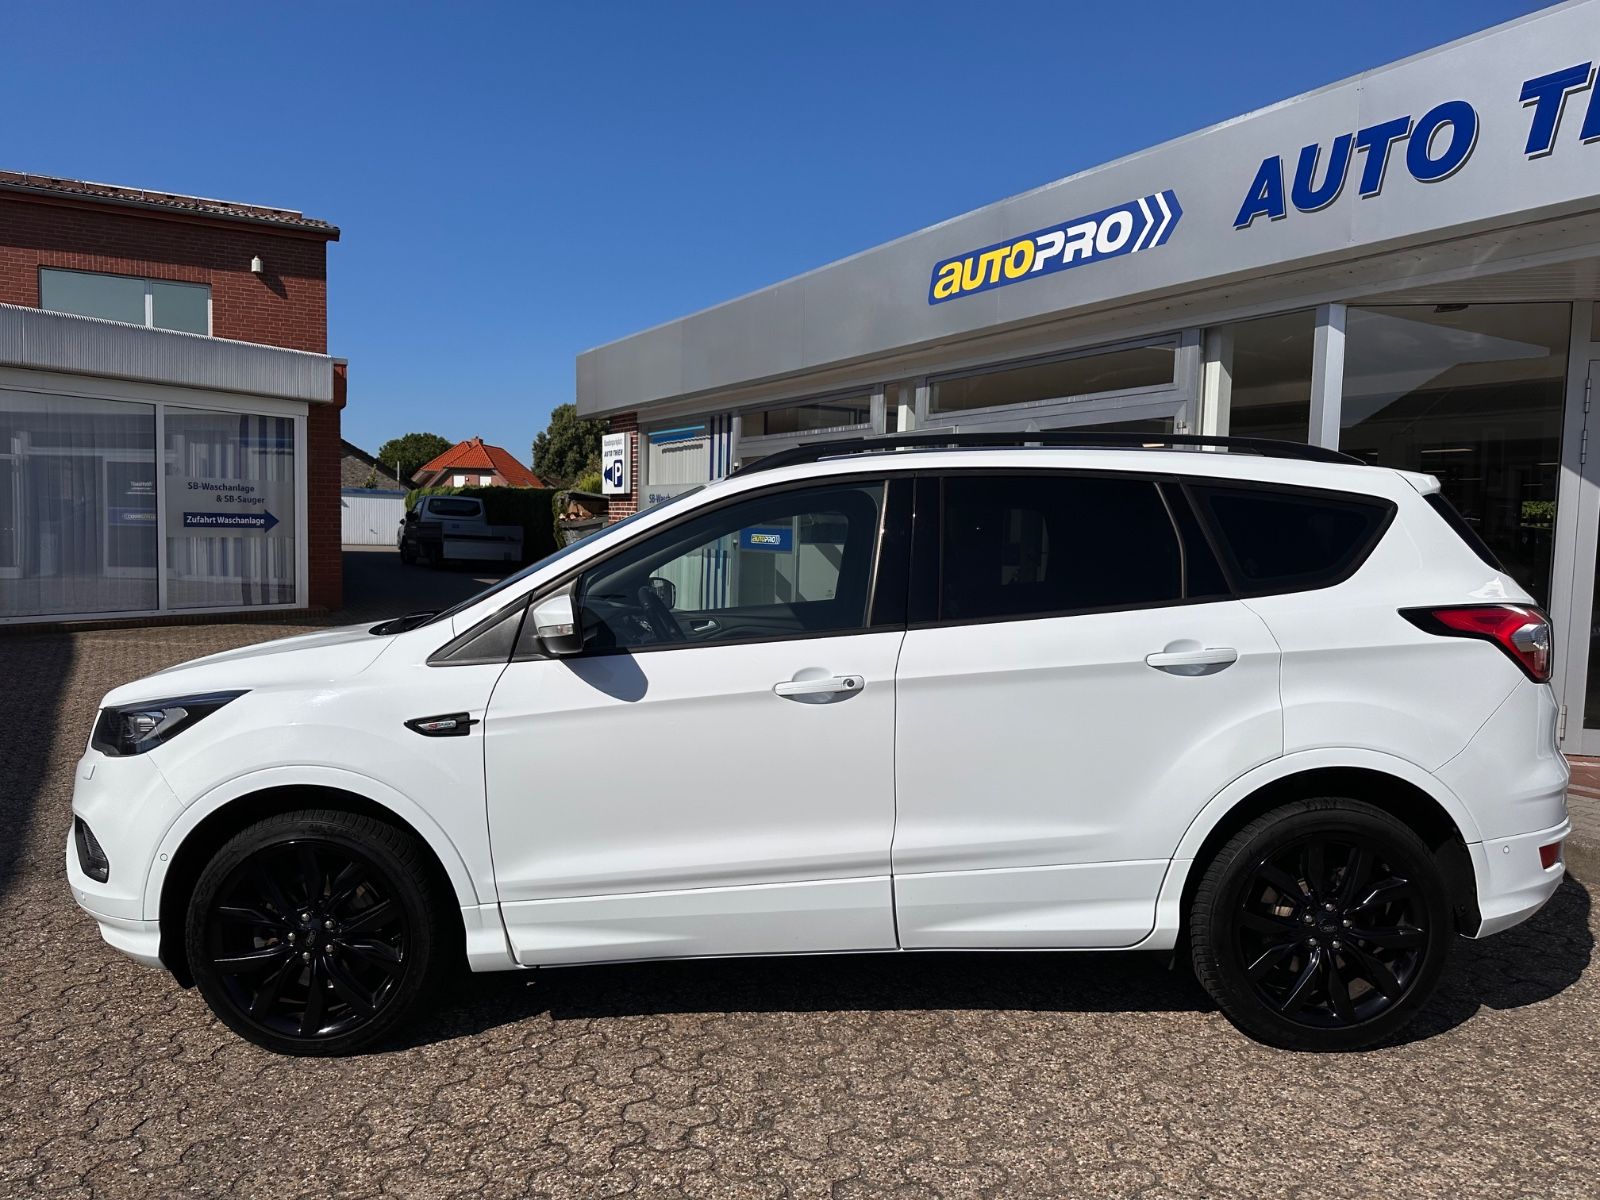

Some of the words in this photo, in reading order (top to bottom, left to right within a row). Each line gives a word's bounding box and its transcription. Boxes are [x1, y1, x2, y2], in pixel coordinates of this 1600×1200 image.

[1233, 100, 1478, 230] AUTO
[614, 462, 622, 485] P
[187, 481, 255, 494] SB-Waschanlage
[216, 495, 222, 503] &
[224, 495, 265, 505] SB-Sauger
[186, 515, 216, 524] Zufahrt
[217, 516, 265, 526] Waschanlage
